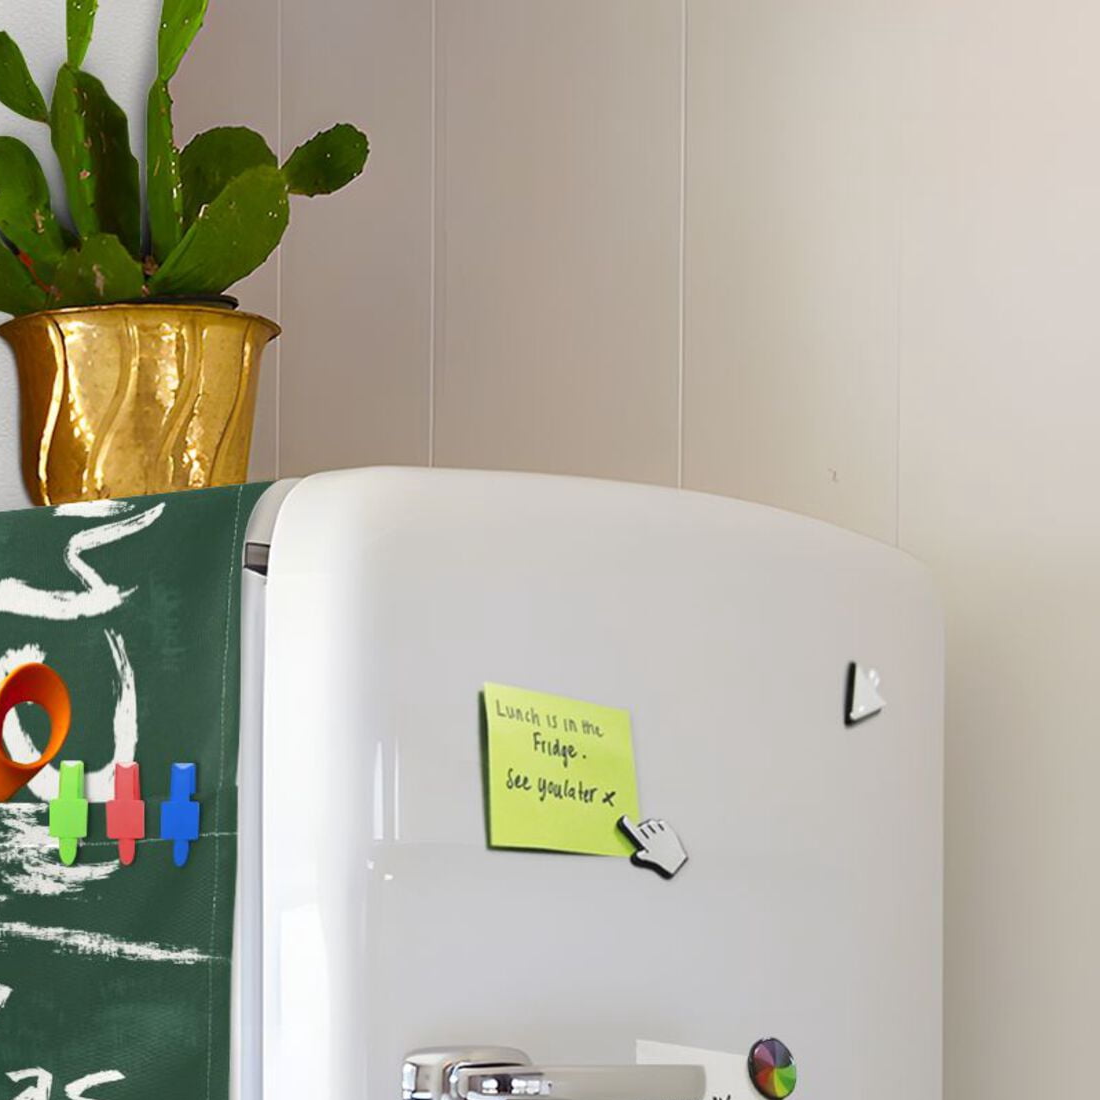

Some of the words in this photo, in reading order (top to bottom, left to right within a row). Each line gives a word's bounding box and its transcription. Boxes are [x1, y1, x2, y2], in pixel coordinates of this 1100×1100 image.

[495, 699, 541, 727] Lunch
[563, 718, 578, 733] in
[581, 719, 604, 738] the
[506, 767, 532, 791] See
